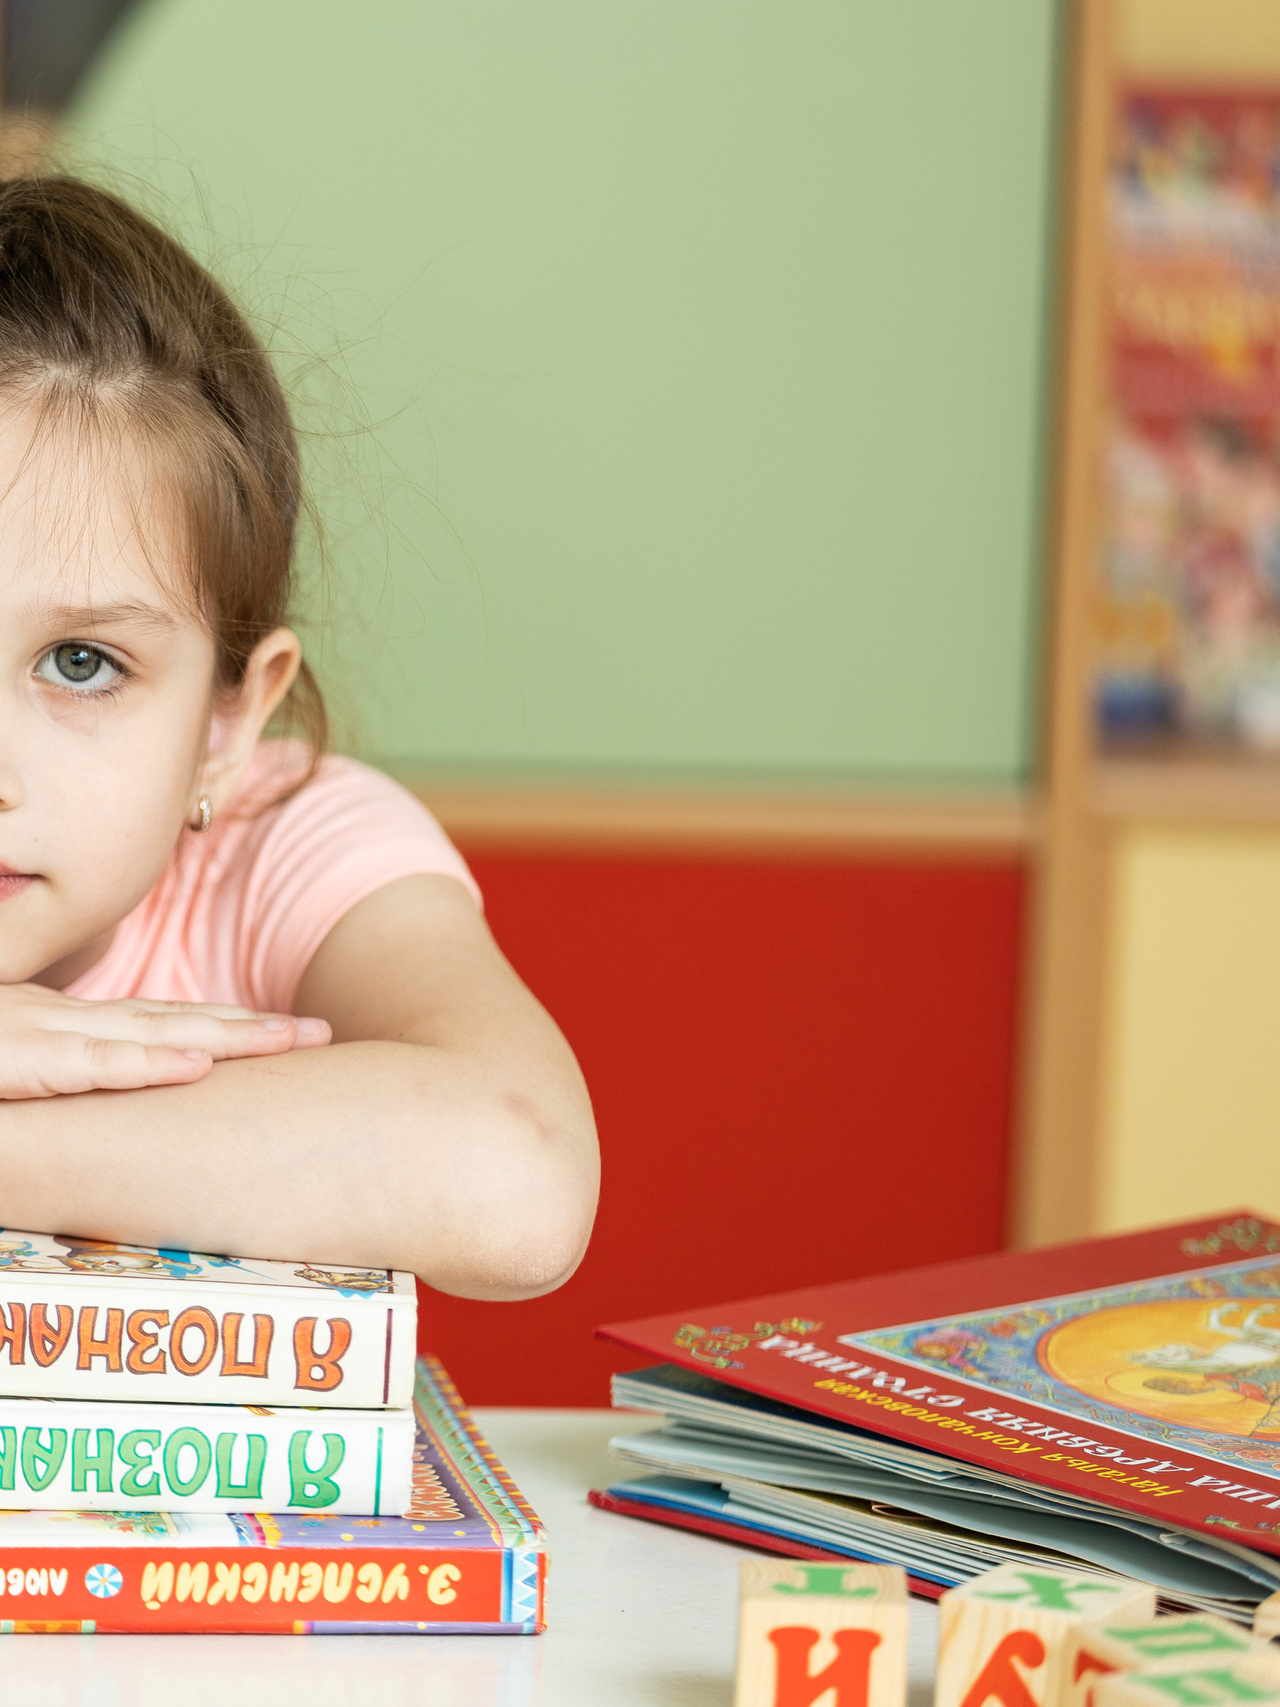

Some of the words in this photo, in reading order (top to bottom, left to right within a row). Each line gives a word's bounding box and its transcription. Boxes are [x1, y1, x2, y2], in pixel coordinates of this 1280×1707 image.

[292, 1316, 354, 1392] Я
[813, 1378, 1044, 1454] Кончаловская
[286, 1429, 347, 1509] Я
[1040, 1452, 1184, 1498] Наталья
[140, 1561, 410, 1610] УСПЕНСКИЙ
[418, 1562, 462, 1605] Э.
